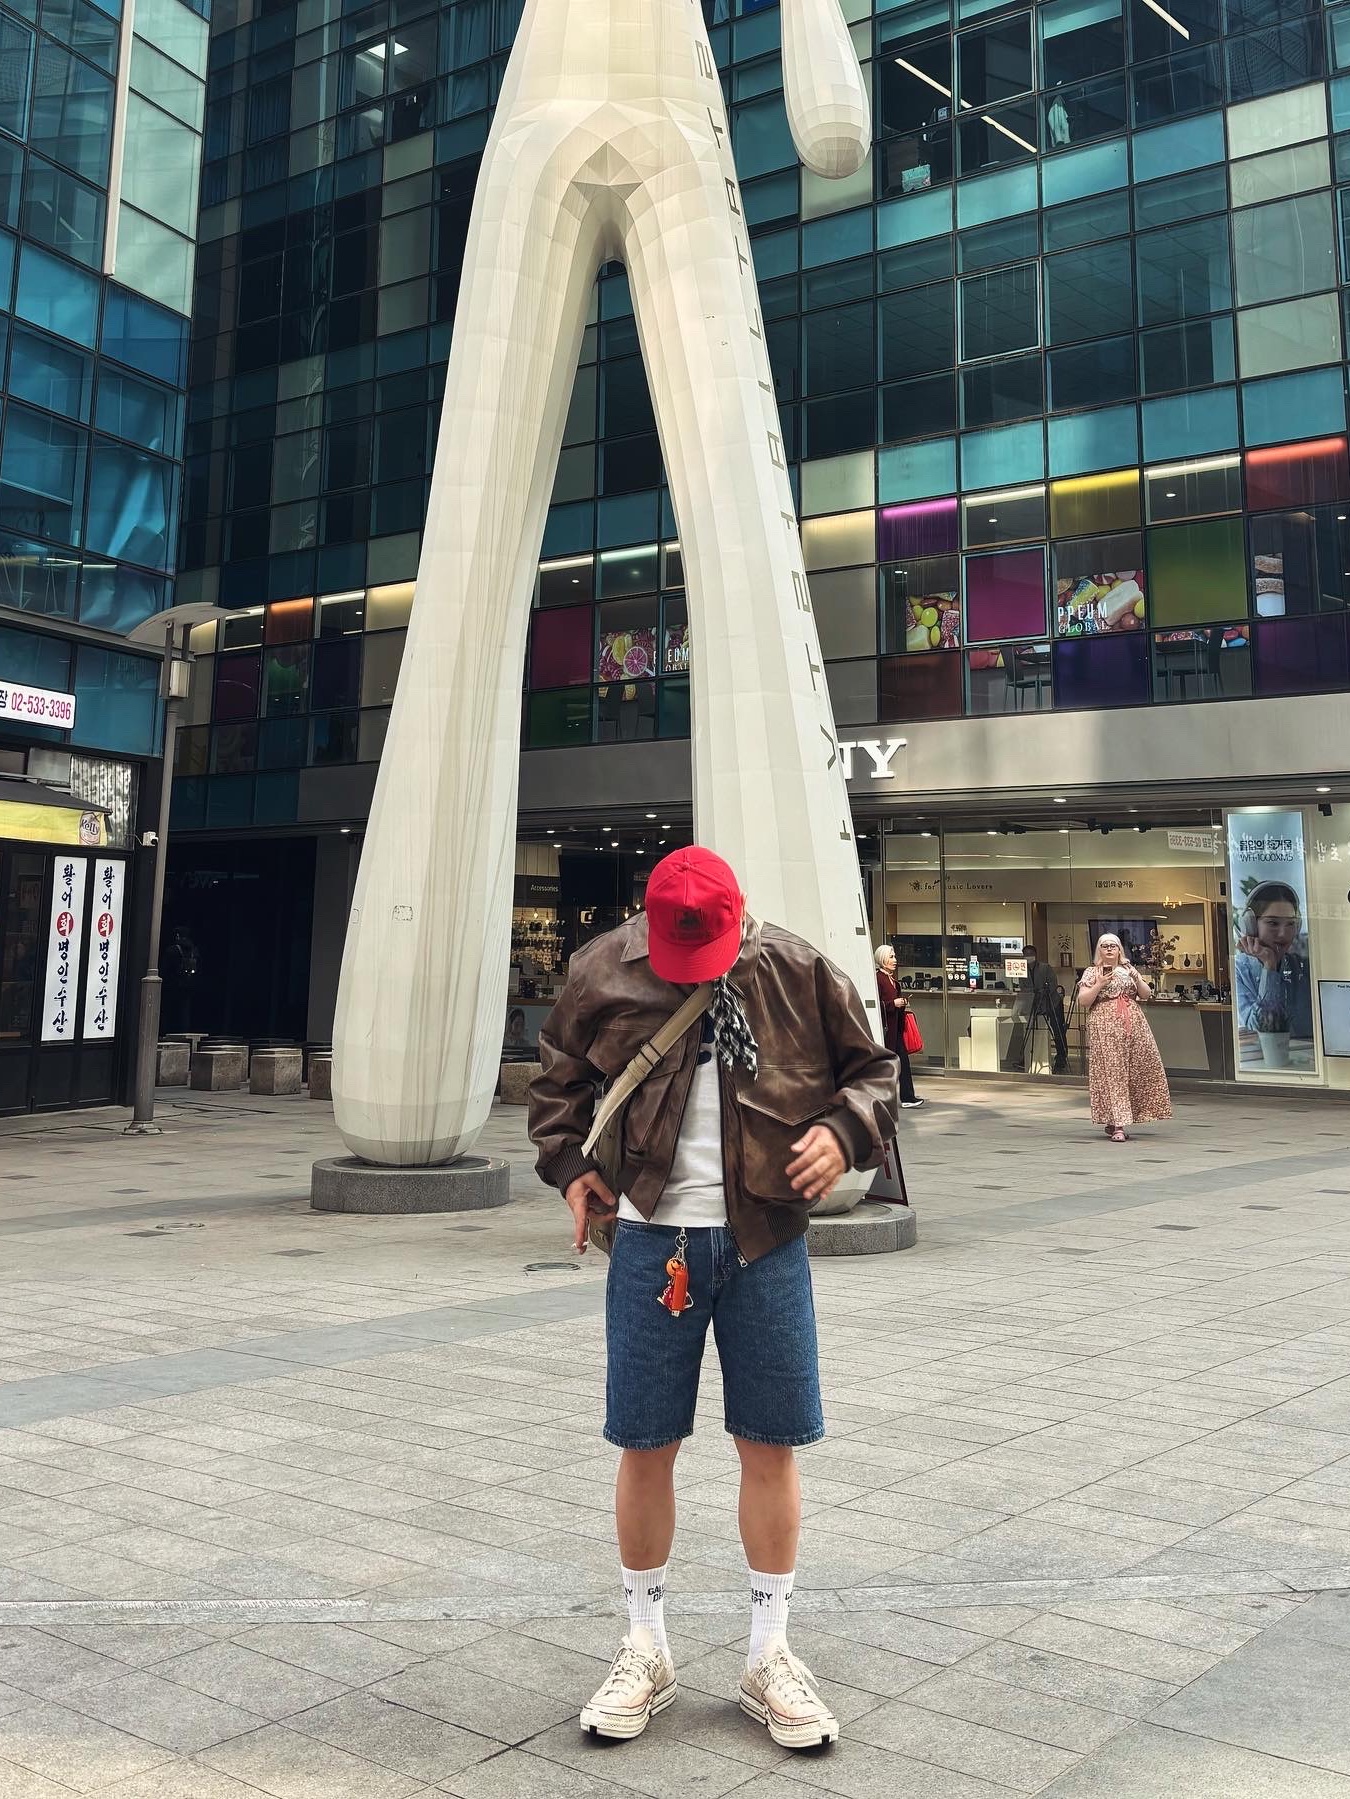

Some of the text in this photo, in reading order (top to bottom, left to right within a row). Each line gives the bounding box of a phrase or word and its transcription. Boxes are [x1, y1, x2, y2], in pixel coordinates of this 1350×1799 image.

[1058, 620, 1109, 634] GLOBAL
[12, 692, 71, 720] 02-533-3396
[531, 884, 559, 892] Accessories
